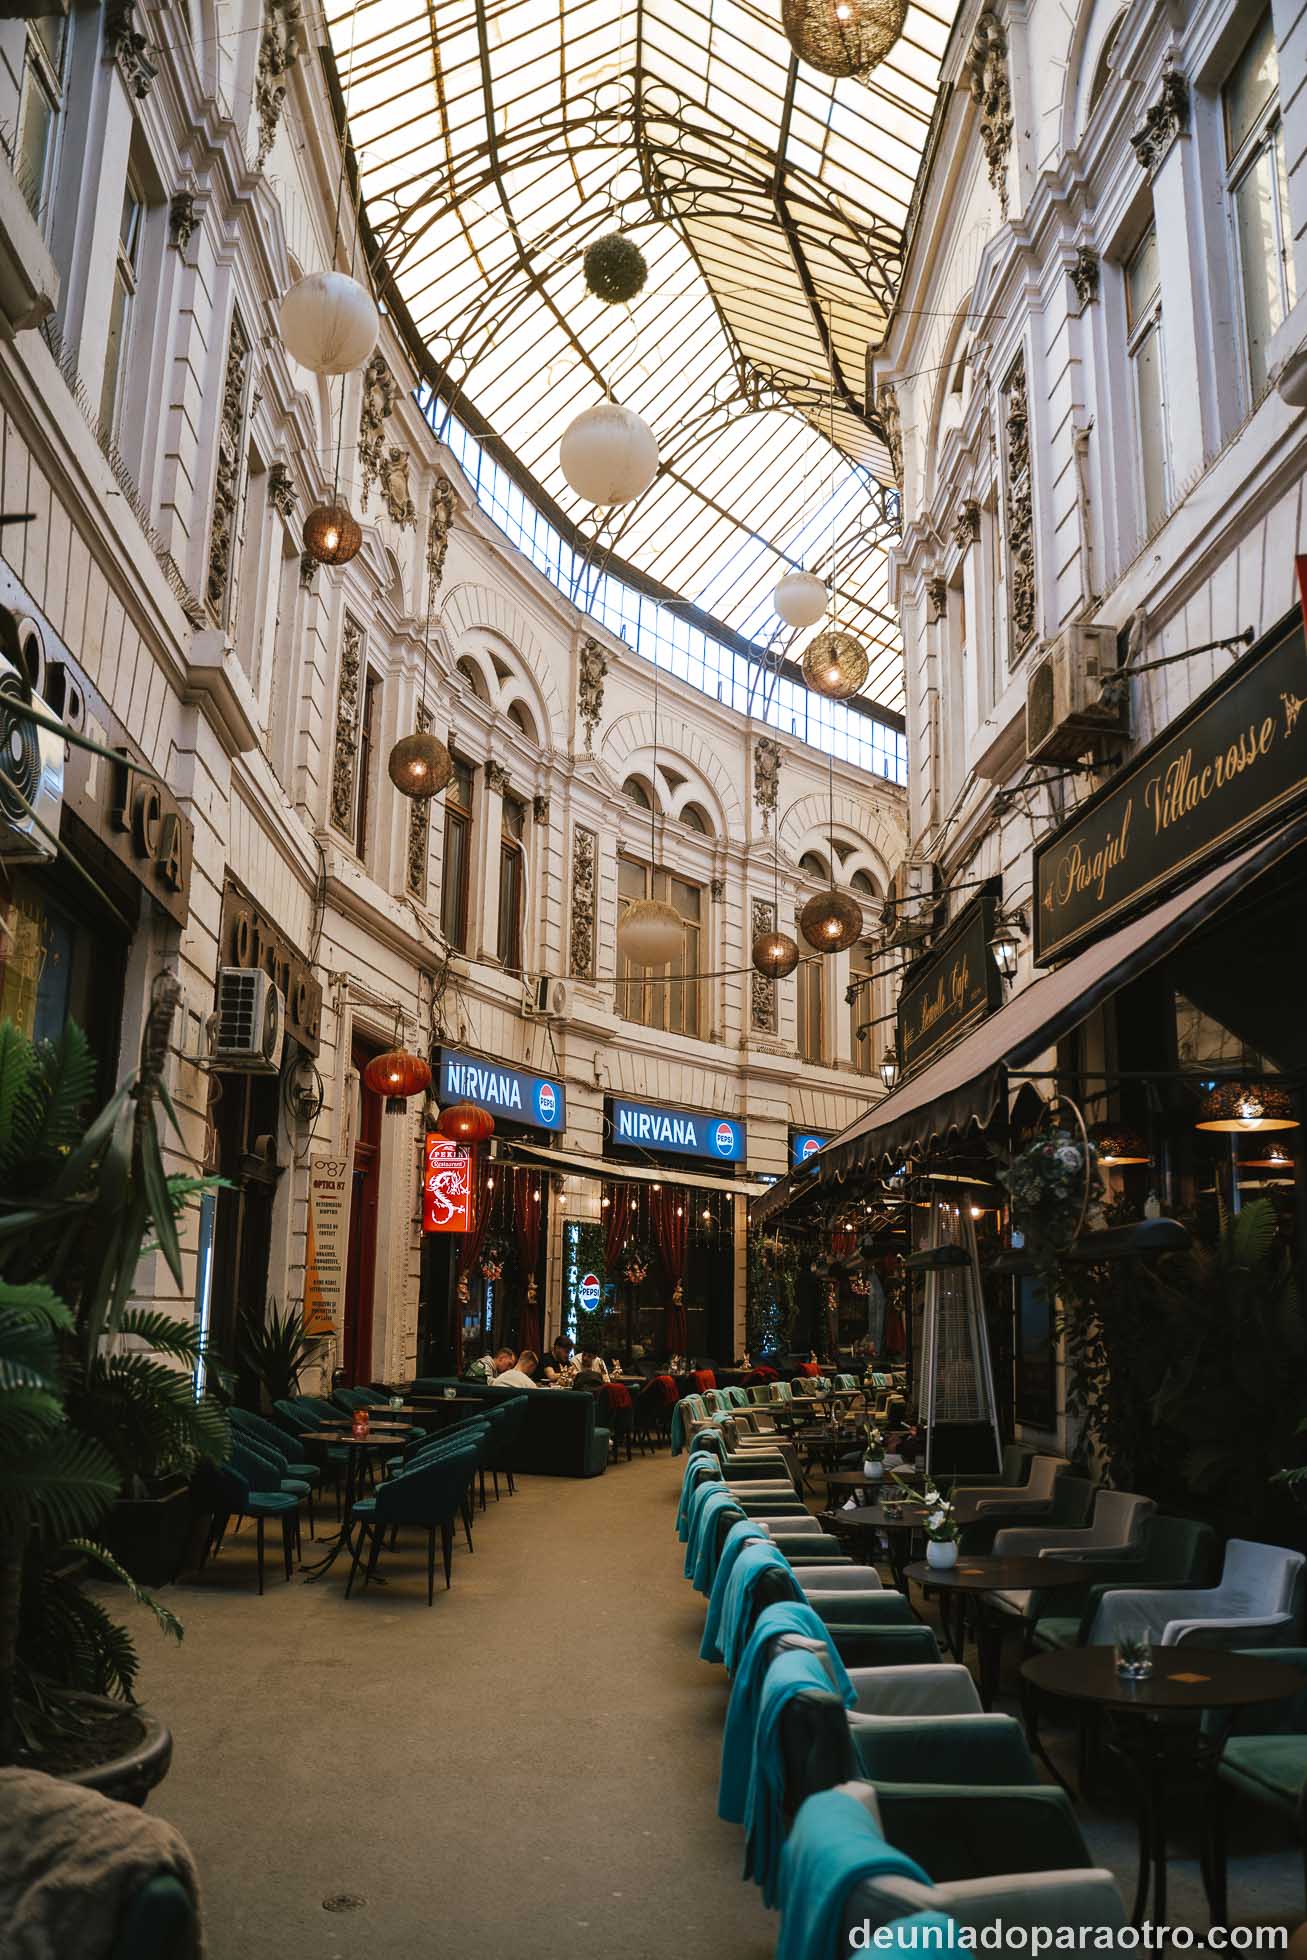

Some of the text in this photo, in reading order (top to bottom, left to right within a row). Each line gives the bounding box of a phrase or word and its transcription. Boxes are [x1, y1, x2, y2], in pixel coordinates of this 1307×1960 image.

[1056, 716, 1277, 905] Pasajul Villacrosse
[447, 1061, 522, 1110] NIRVANA
[540, 1097, 555, 1109] PEPSI
[619, 1109, 697, 1146] NIRVANA
[717, 1134, 733, 1144] PEPSI
[582, 1288, 600, 1297] PEPSI
